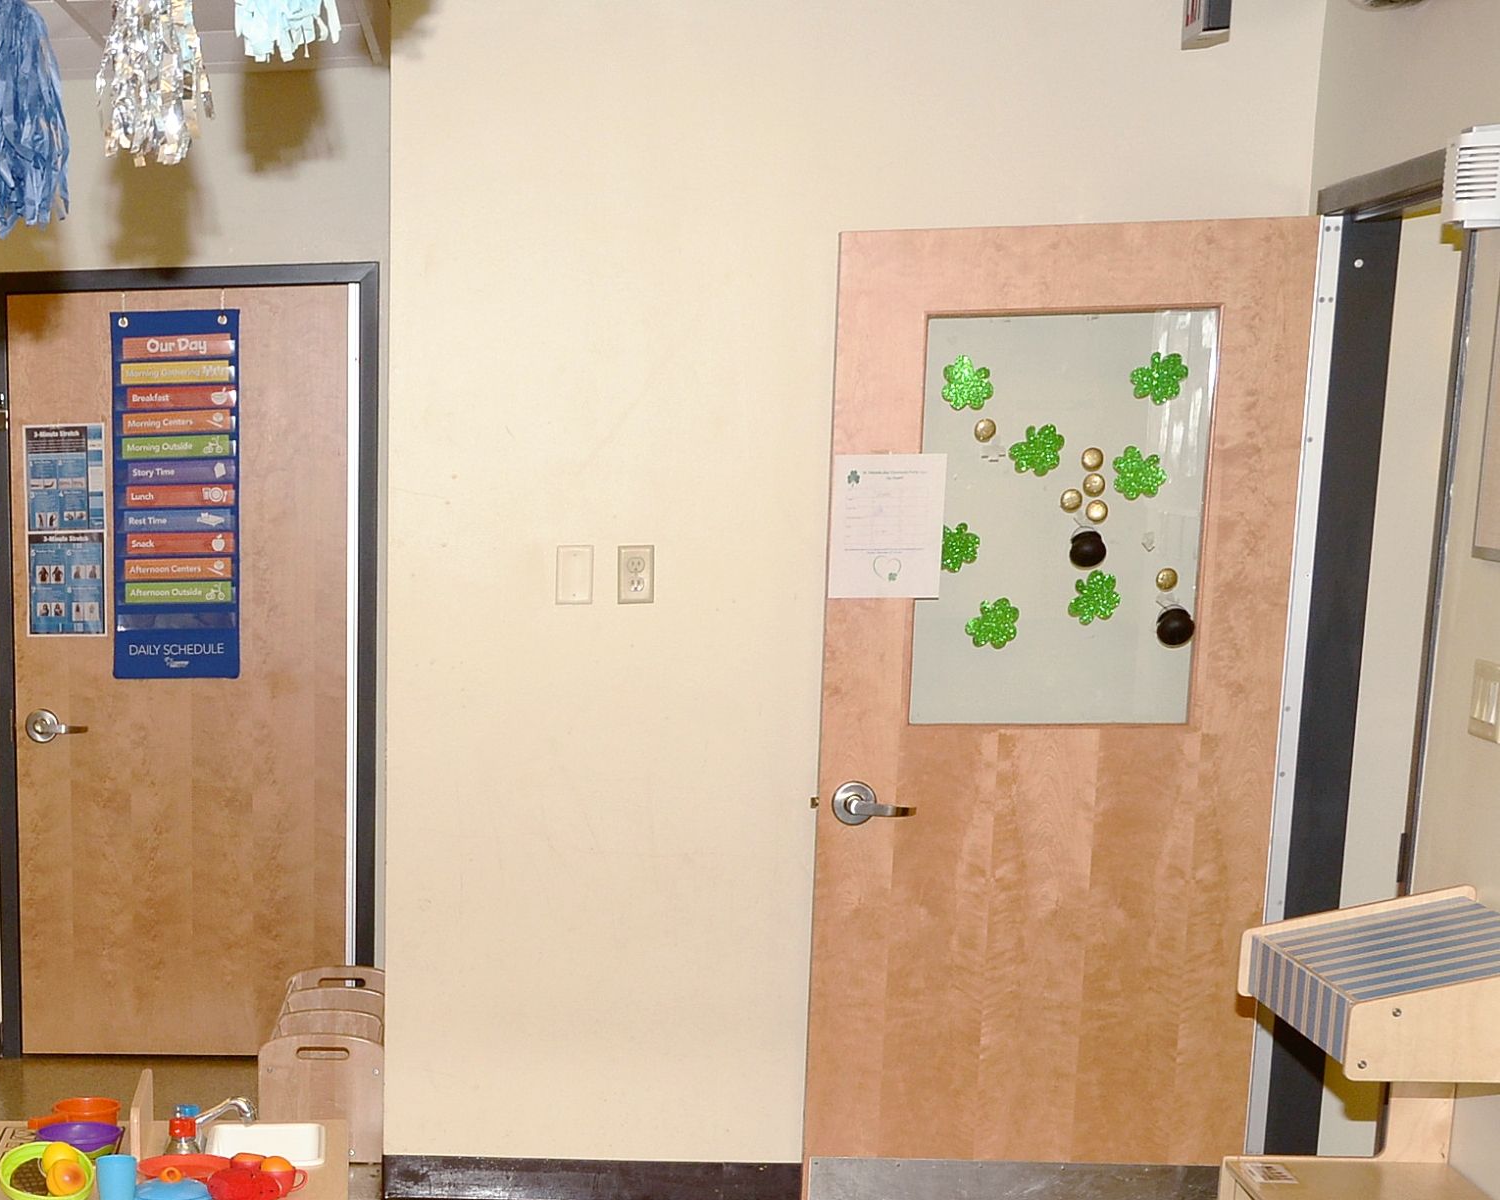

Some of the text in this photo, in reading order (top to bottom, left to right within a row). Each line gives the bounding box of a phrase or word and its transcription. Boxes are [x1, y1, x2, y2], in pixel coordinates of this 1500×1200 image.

[146, 338, 207, 354] Our Day
[131, 393, 170, 403] Breakfast
[128, 418, 194, 429] Morning Centers
[126, 441, 193, 453] Morning Outside
[132, 467, 175, 478] Story Time
[130, 492, 154, 501] Lunch
[128, 516, 168, 526] Rest Time
[131, 540, 155, 549] Snack
[129, 564, 202, 574] Afternoon Centers
[130, 587, 203, 597] Afternoon Outside
[128, 643, 225, 656] DAILY SCHEDULE
